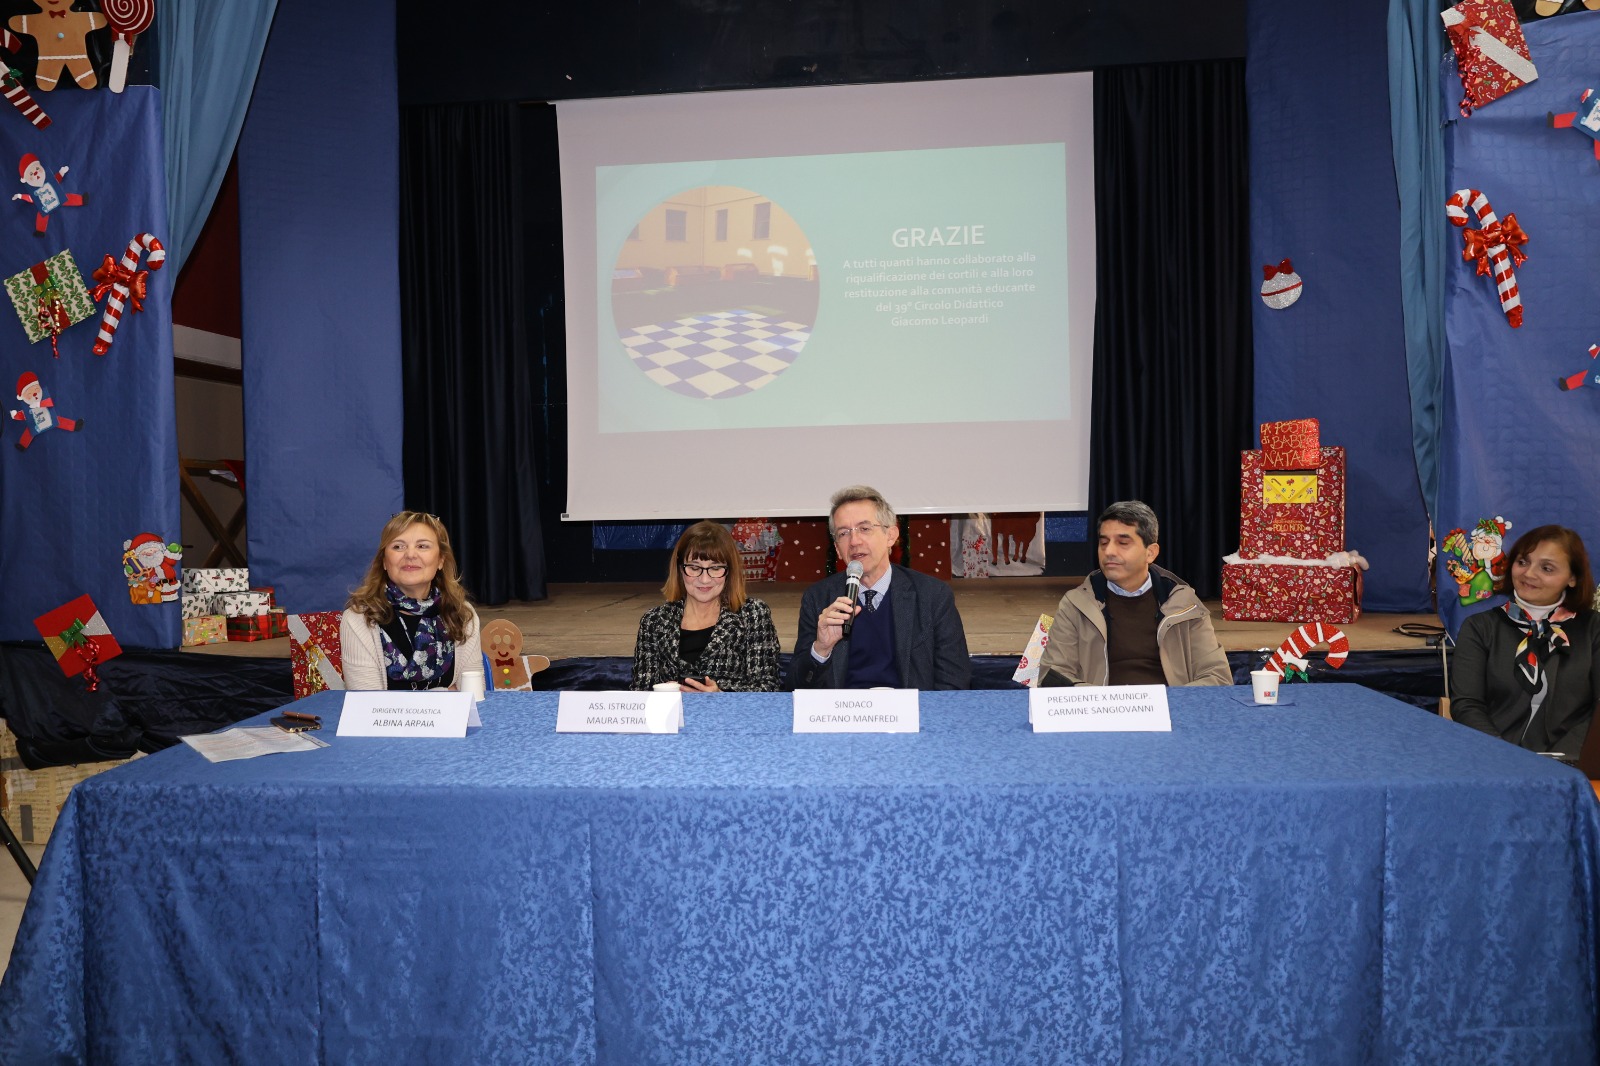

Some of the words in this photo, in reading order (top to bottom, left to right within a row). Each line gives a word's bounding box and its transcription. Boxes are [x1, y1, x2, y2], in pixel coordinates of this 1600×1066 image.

[892, 225, 985, 248] GRAZIE
[843, 260, 851, 269] A
[853, 258, 877, 268] tutti
[879, 257, 914, 270] quanti
[916, 256, 950, 266] hanno
[952, 254, 1014, 265] collaborato
[1016, 252, 1036, 262] alla
[845, 272, 927, 285] riqualificazione
[929, 271, 945, 280] dei
[948, 268, 979, 279] cortili
[990, 268, 1009, 278] alla
[1012, 267, 1034, 277] loro
[844, 287, 908, 298] restituzione
[910, 285, 929, 296] alla
[931, 284, 982, 295] comunità
[985, 283, 1036, 293] educante
[875, 302, 892, 312] del
[894, 302, 913, 314] 39°
[914, 300, 951, 311] Circolo
[954, 299, 1004, 309] Didattico
[891, 316, 939, 327] Giacomo
[941, 314, 989, 327] Leopardi
[1260, 448, 1320, 467] NATALE
[1047, 694, 1100, 704] PRESIDENTE
[1109, 692, 1152, 701] MUNICIP.
[588, 702, 606, 710] ASS.
[834, 700, 873, 709] SINDACO
[1047, 707, 1089, 717] CARMINE
[1091, 705, 1154, 715] SANGIOVANNI
[372, 719, 403, 727] ALBINA
[404, 719, 435, 728] ARPAIA
[586, 716, 619, 725] MAURA
[809, 714, 851, 723] GAETANO
[852, 714, 899, 723] MANFREDI
